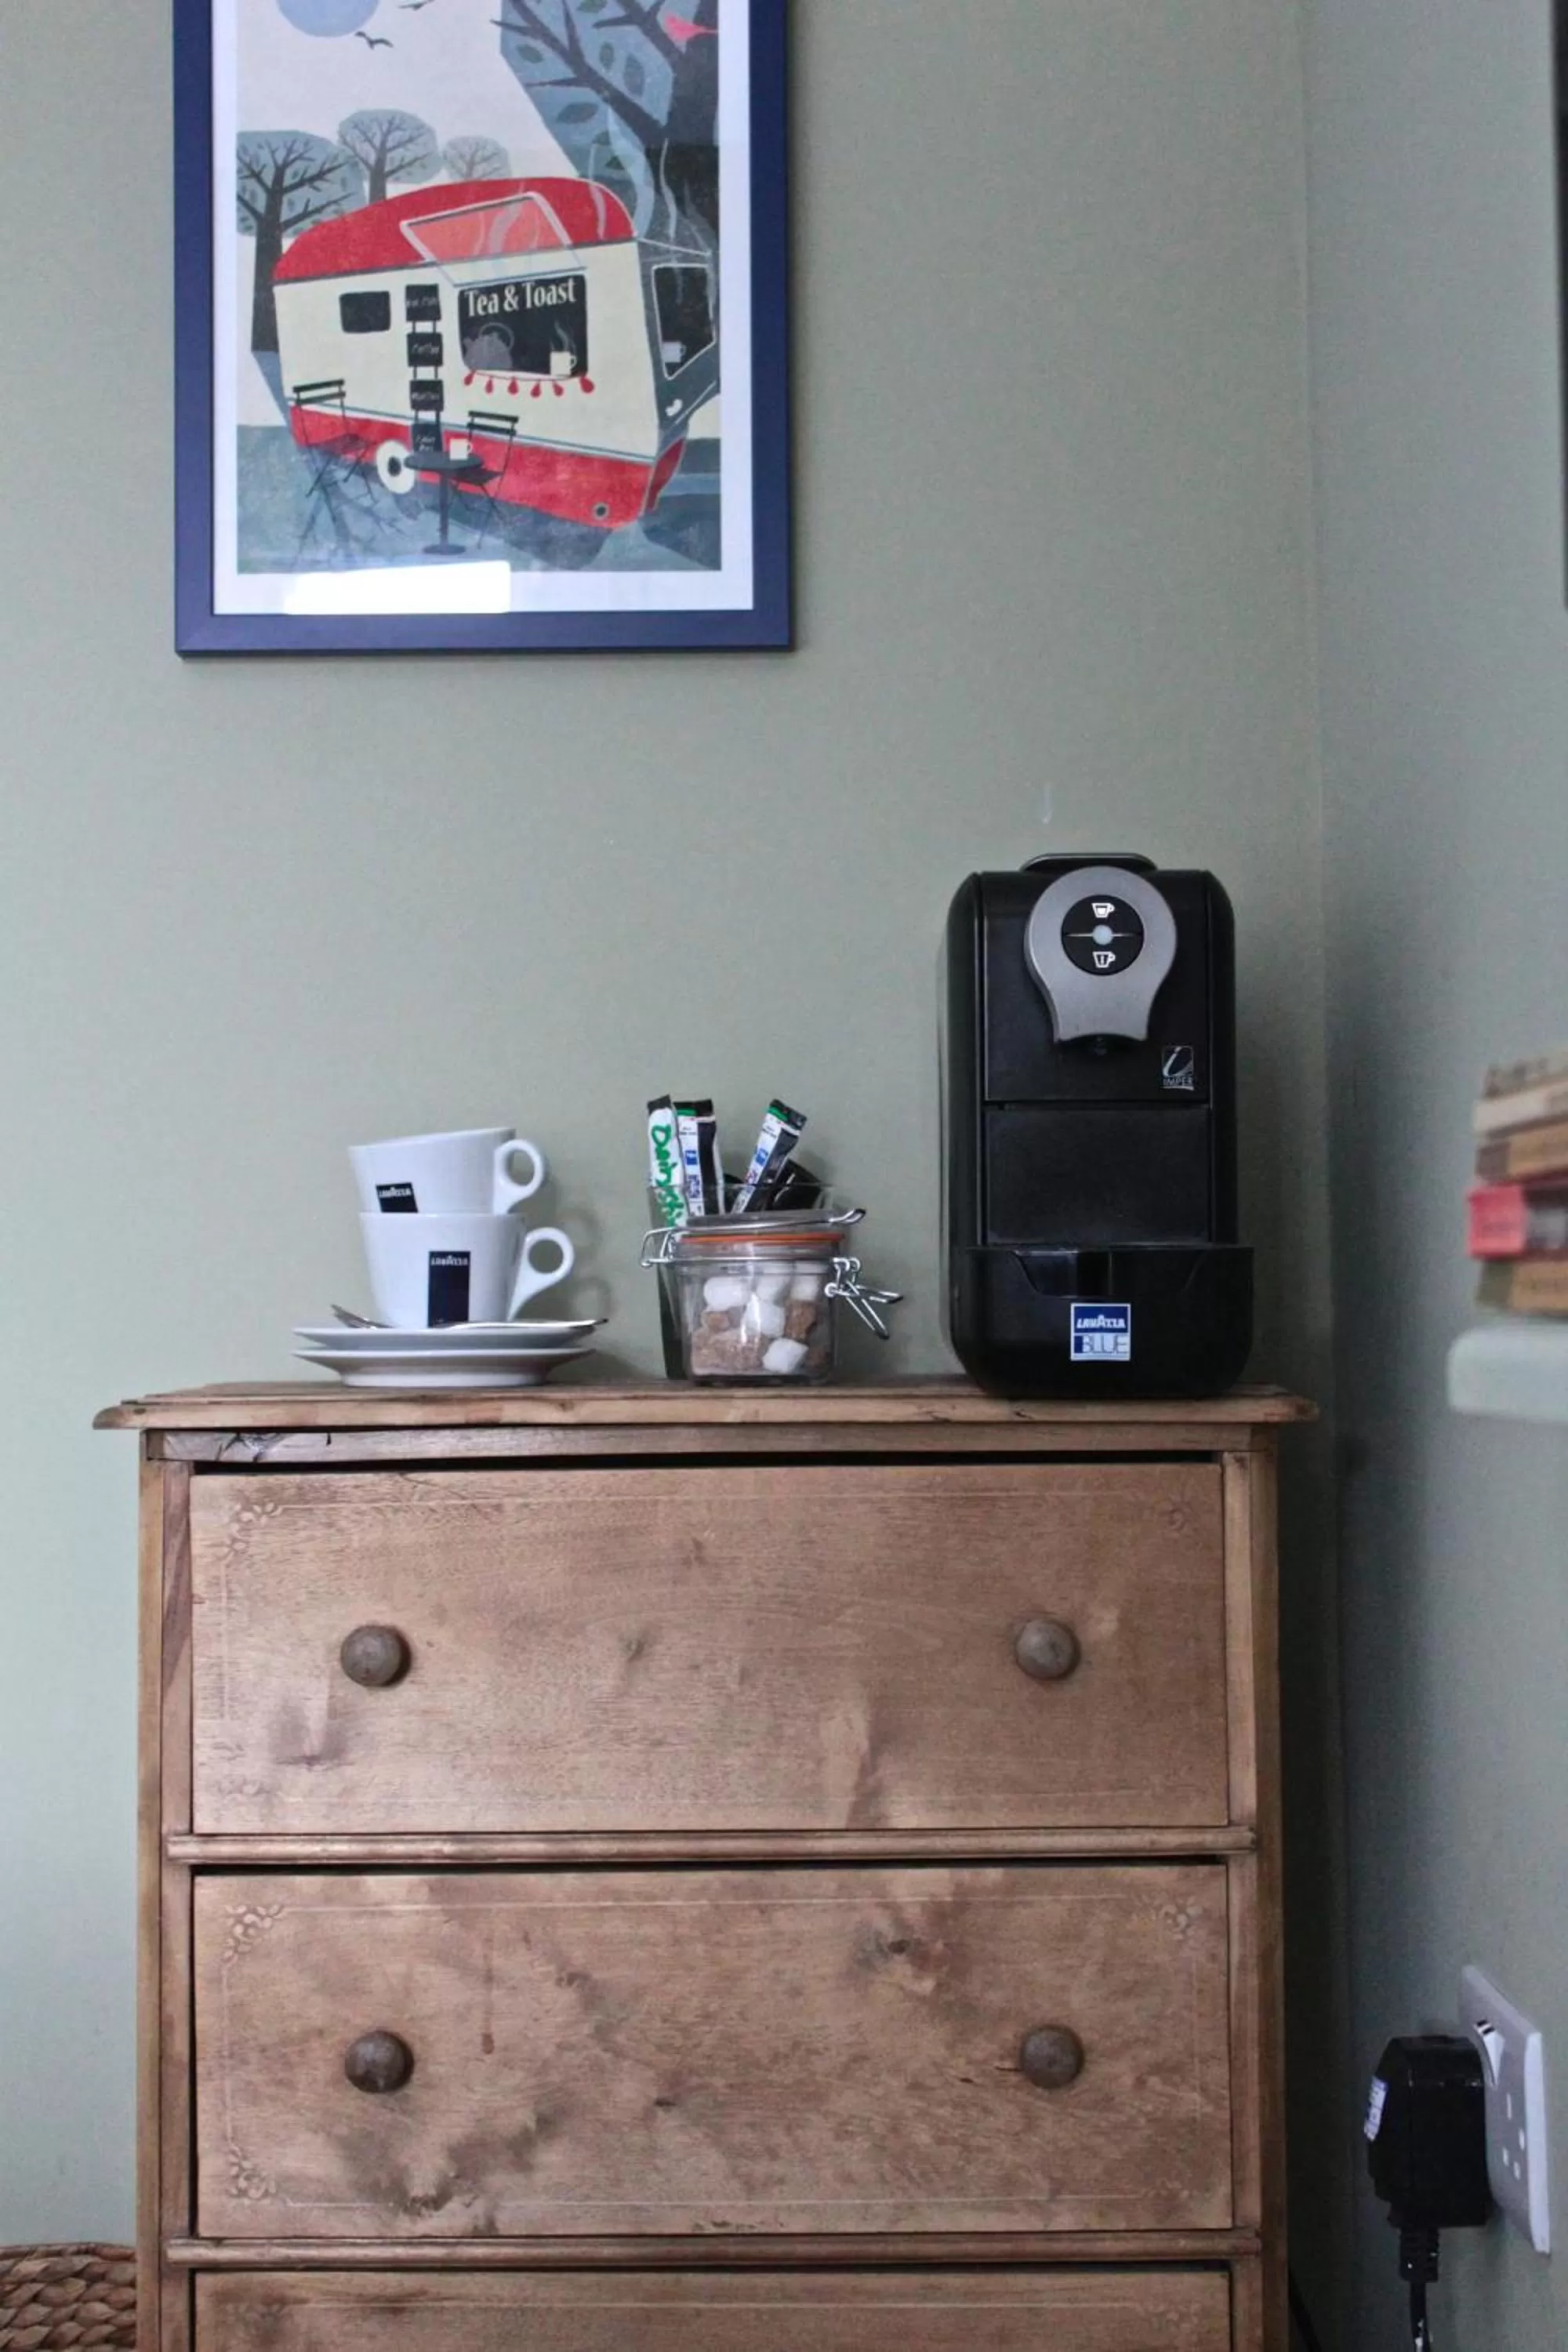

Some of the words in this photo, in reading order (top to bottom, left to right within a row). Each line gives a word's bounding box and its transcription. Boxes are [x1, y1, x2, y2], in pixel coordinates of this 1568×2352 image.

[464, 289, 499, 317] Tea
[503, 284, 519, 311] &
[521, 278, 576, 309] Toast
[1076, 1314, 1126, 1329] LAVAZZA
[1082, 1334, 1130, 1355] BLUE
